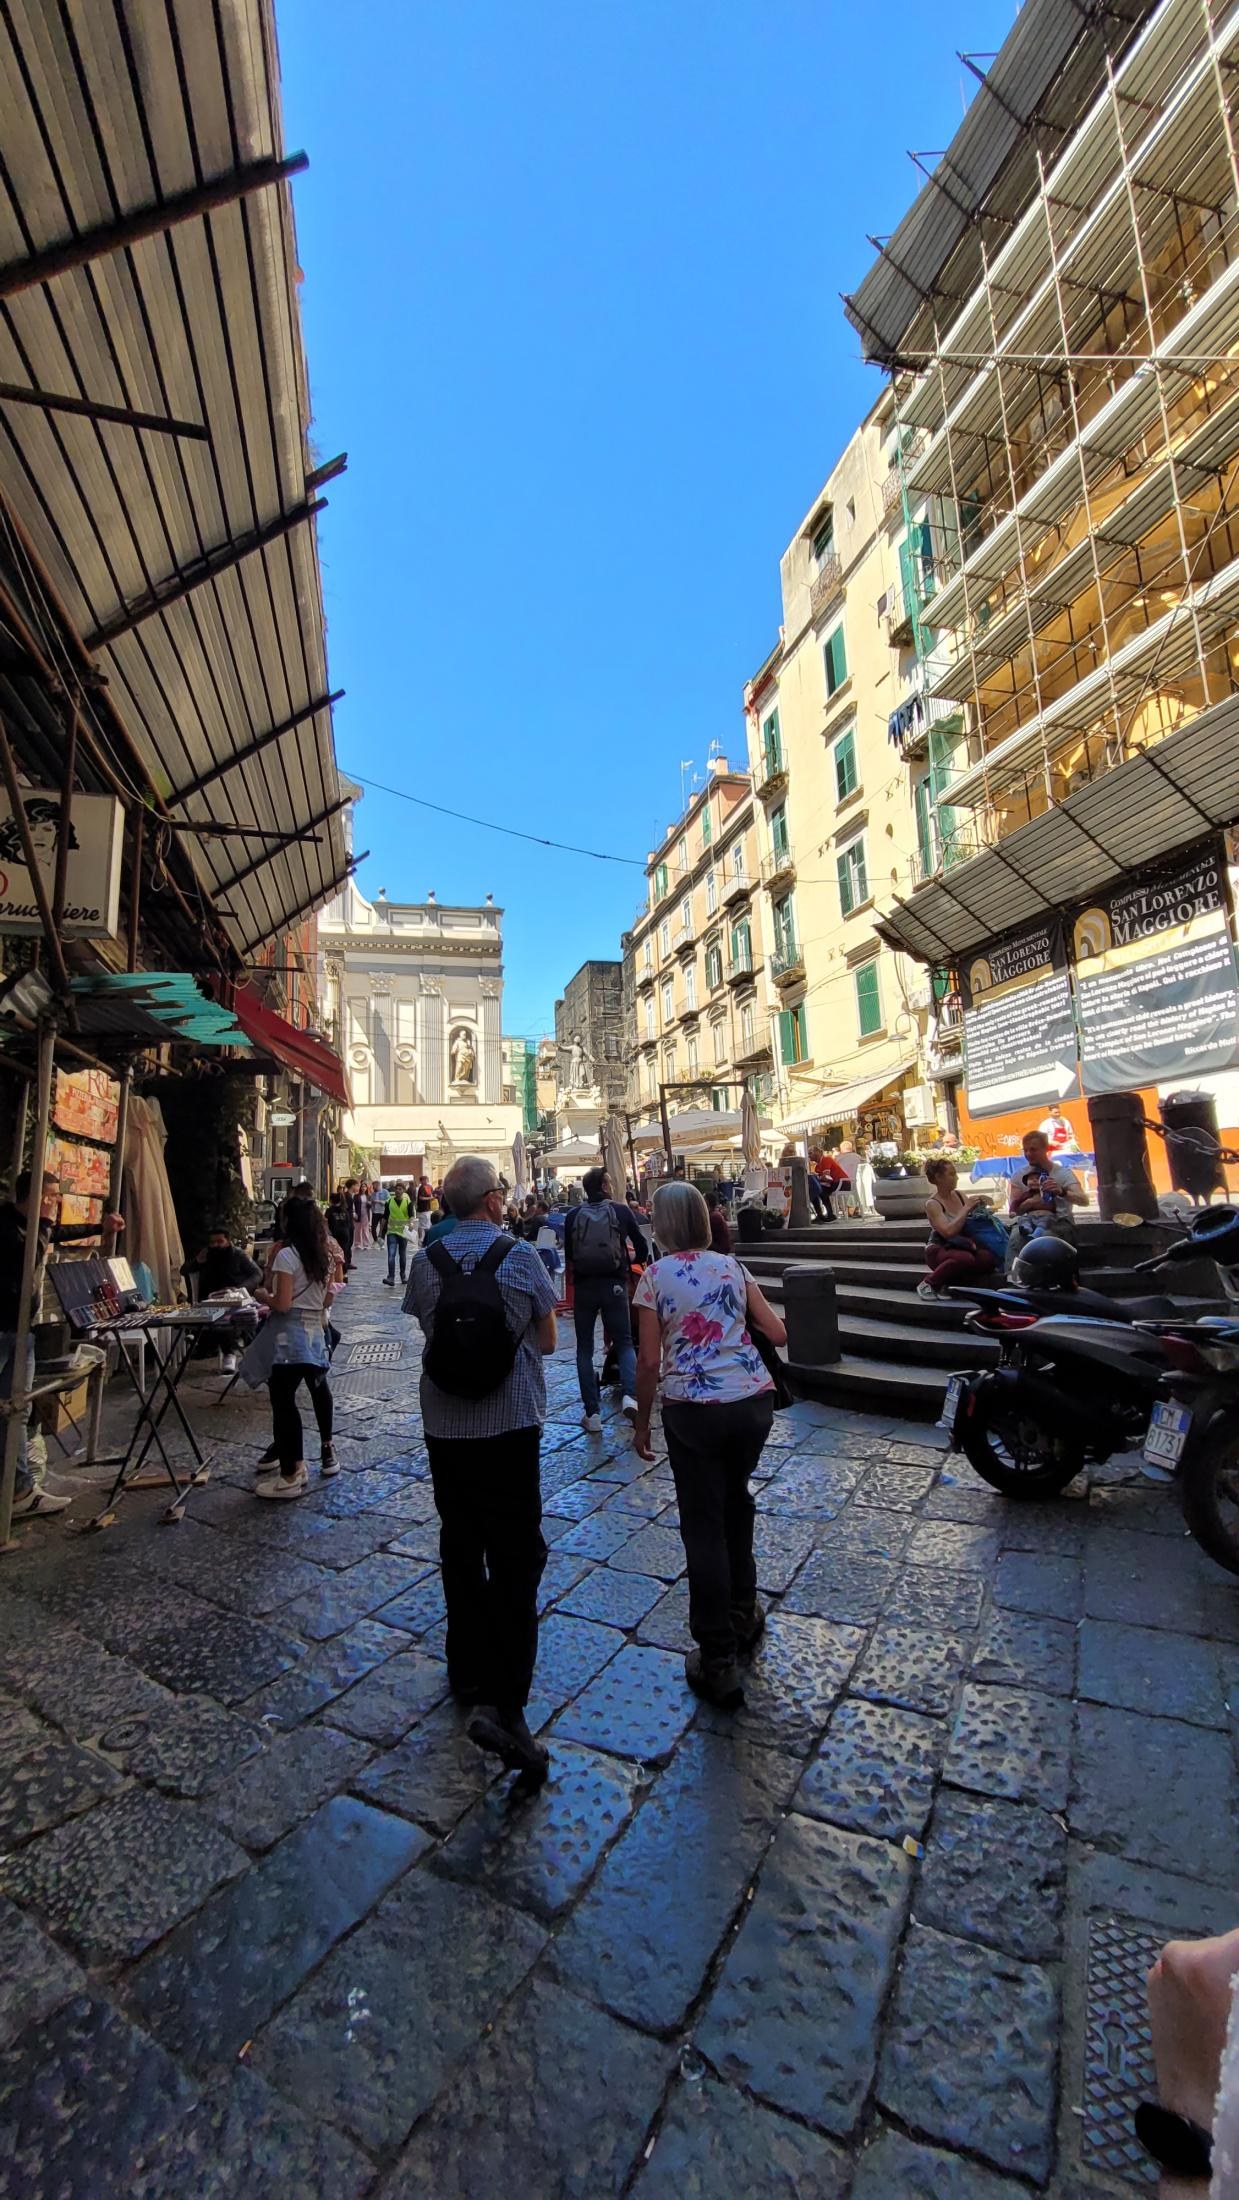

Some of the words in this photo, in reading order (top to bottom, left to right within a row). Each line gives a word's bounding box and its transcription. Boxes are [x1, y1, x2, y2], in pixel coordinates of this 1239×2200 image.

[1110, 887, 1149, 910] COMPLESSO
[1111, 904, 1139, 928] SAN
[1140, 870, 1218, 915] LORENZO
[1113, 889, 1220, 947] MAGGIORE
[989, 956, 1006, 971] SAN
[1006, 937, 1049, 964] LORENZO
[991, 949, 1051, 985] MAGGIORE
